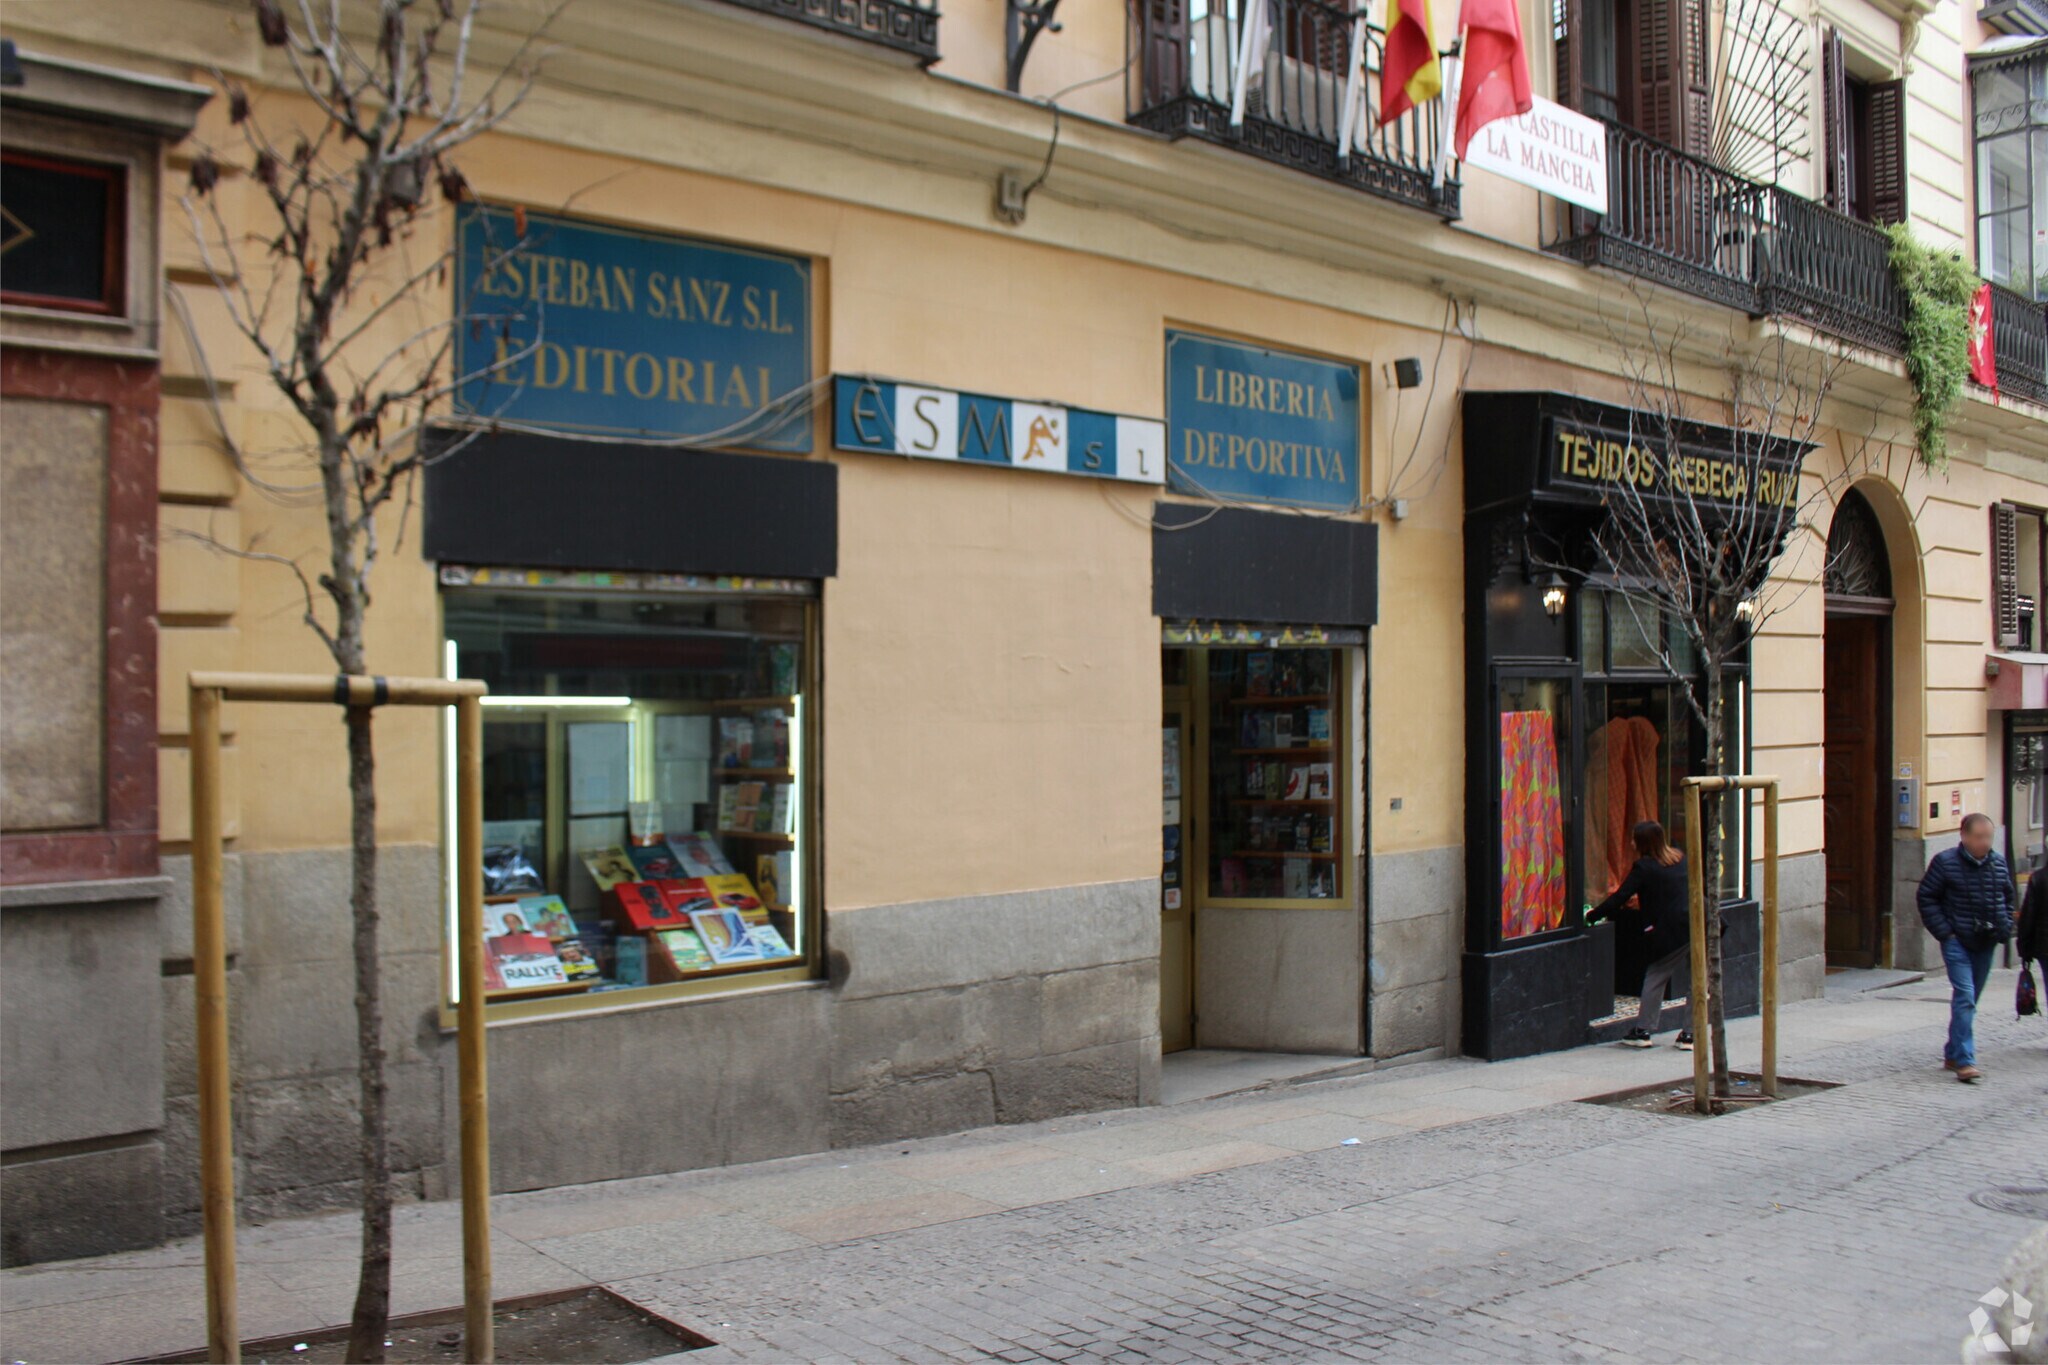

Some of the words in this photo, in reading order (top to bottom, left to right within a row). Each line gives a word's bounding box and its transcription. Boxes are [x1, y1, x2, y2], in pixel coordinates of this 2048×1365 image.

[1486, 127, 1512, 162] LA
[1520, 141, 1597, 195] MANCHA
[1518, 111, 1601, 164] CASTILLA
[482, 245, 637, 314] ESTEBAN
[647, 270, 731, 328] SANZ
[741, 285, 794, 334] S.L.
[495, 336, 786, 413] EDITORIAL
[1195, 364, 1335, 422] LIBRERIA
[1183, 428, 1346, 484] DEPORTIVA
[1558, 432, 1654, 488] TEJIDOS
[1669, 454, 1747, 501] REBECA
[1758, 468, 1798, 508] RUIZ
